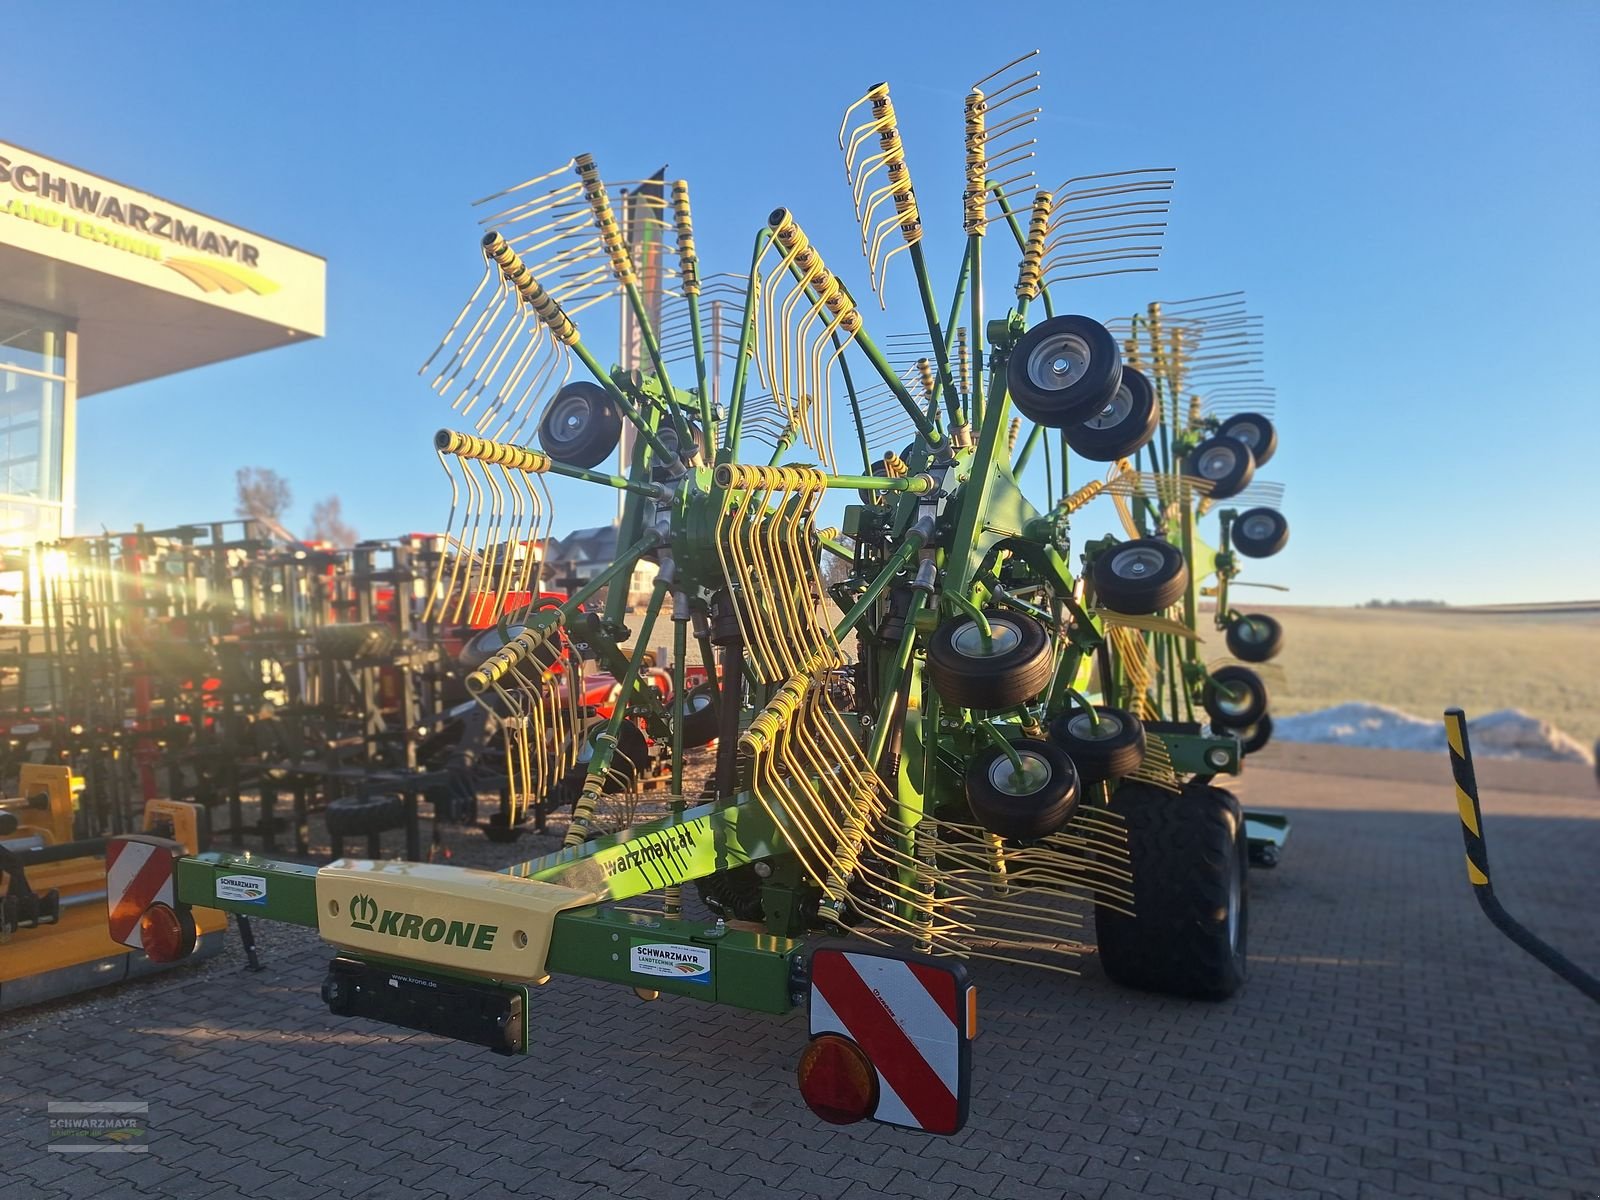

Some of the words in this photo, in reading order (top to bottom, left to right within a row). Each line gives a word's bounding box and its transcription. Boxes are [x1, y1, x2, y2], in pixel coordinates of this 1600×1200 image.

[0, 156, 259, 267] SCHWARZMAYR
[0, 199, 162, 261] ANDTECHNIK
[378, 910, 498, 951] KRONE
[637, 947, 698, 964] SCHWARZMAYR
[638, 956, 674, 967] LANDTECHNIK
[391, 974, 437, 988] www.krone.de
